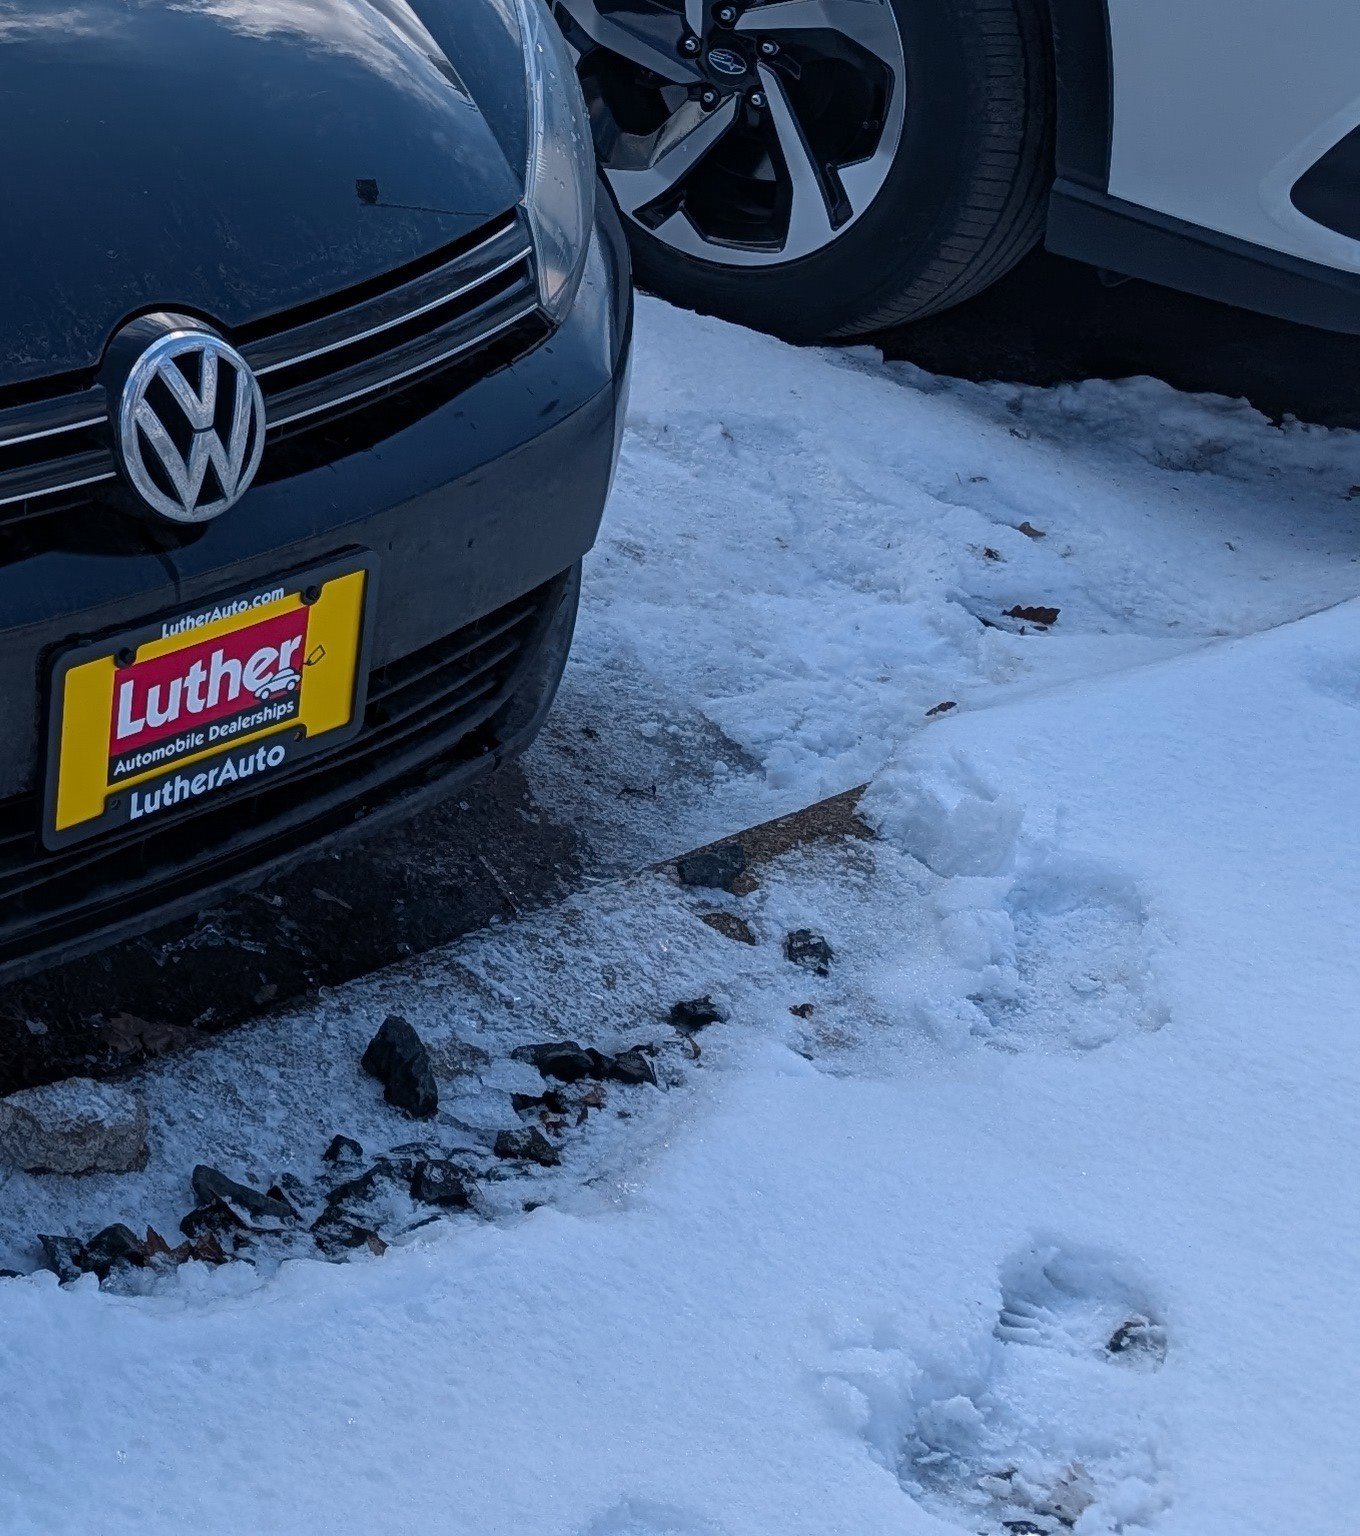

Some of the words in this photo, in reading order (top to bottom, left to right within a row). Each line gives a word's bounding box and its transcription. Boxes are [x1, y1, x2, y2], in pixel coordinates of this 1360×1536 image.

[124, 333, 263, 520] VW
[161, 587, 285, 639] LutherAuto.com
[116, 634, 303, 740] Luther
[113, 732, 205, 777] Automobile
[208, 700, 295, 741] Dealerships
[130, 745, 286, 821] LutherAuto
